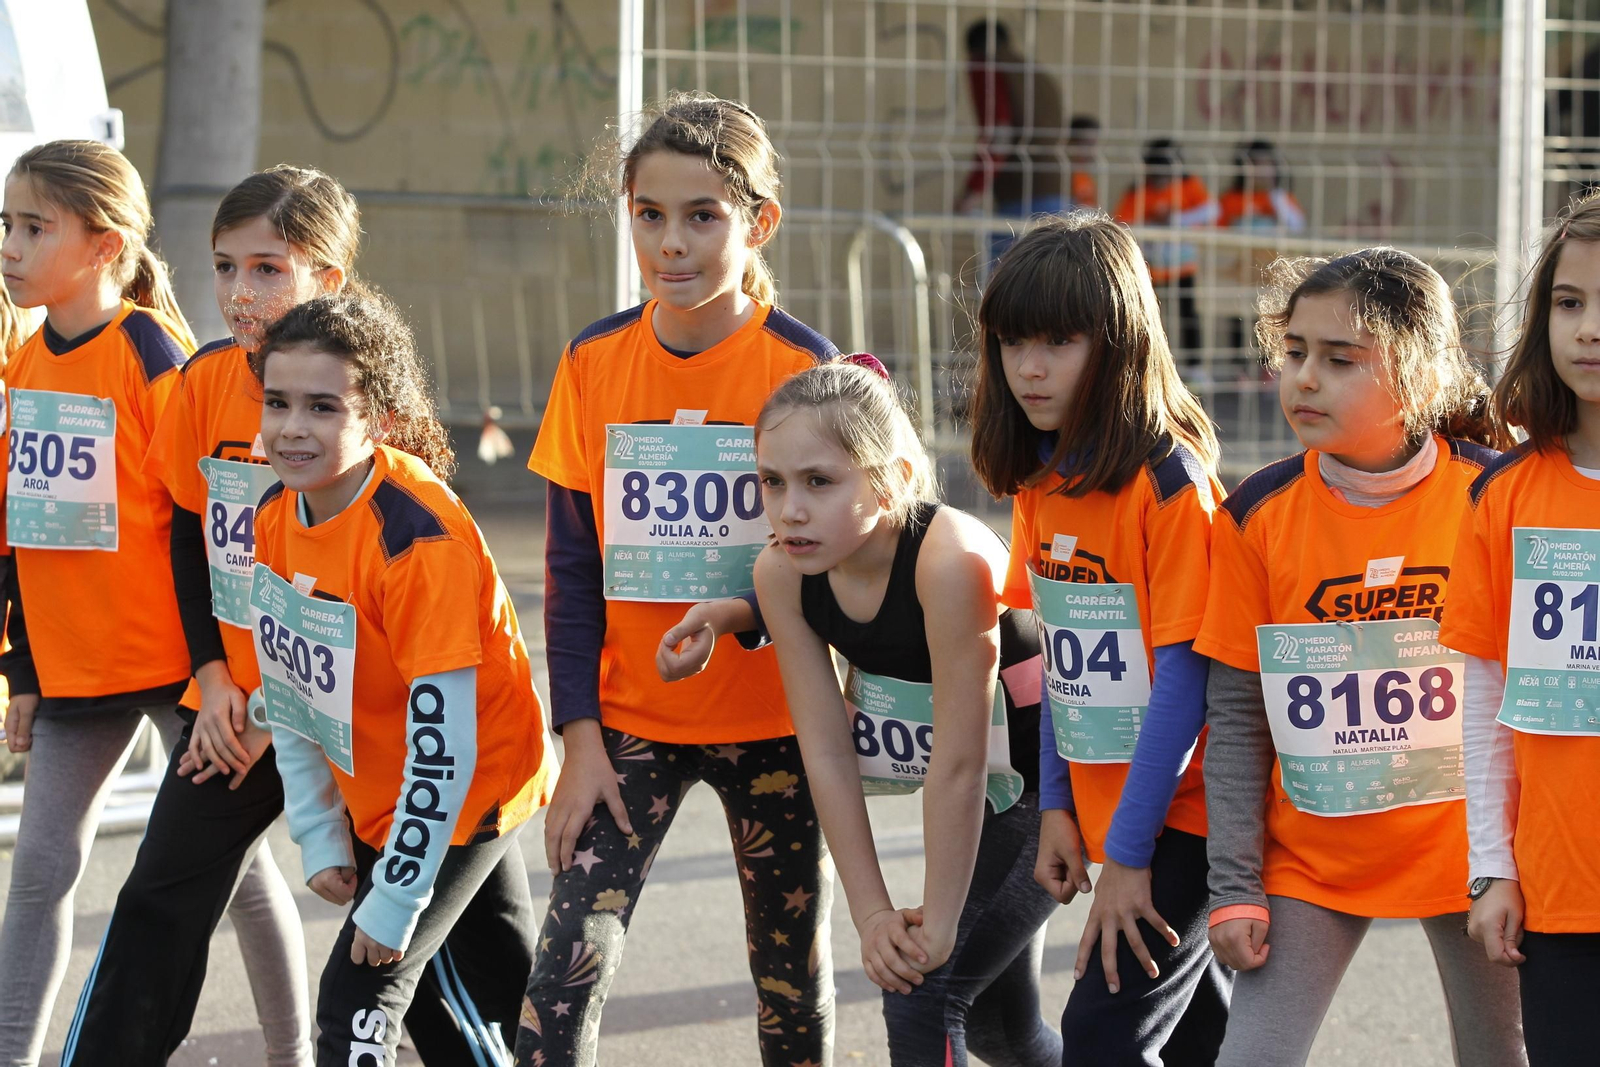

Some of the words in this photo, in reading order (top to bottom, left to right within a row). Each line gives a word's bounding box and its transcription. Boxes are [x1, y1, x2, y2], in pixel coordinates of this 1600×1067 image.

[58, 403, 106, 417] CARRERA
[59, 416, 106, 429] INFANTIL
[638, 444, 678, 452] MARATÓN
[638, 452, 673, 460] ALMERÍA
[23, 478, 50, 491] AROA
[622, 470, 764, 522] 8300
[212, 502, 255, 552] 84
[649, 524, 694, 537] JULIA
[698, 525, 714, 538] A.
[1555, 542, 1582, 550] MEDIO
[1554, 552, 1596, 561] MARATÓN
[1552, 561, 1590, 570] ALMERÍA
[1066, 594, 1126, 606] CARRERA
[1334, 582, 1440, 617] SUPER
[300, 606, 344, 624] CARRERA
[1069, 609, 1127, 620] INFANTIL
[1532, 582, 1600, 642] 81
[302, 620, 343, 638] INFANTIL
[1305, 636, 1335, 644] MEDIO
[260, 614, 336, 694] 8503
[1306, 644, 1352, 654] MARATÓN
[1306, 652, 1348, 663] ALMERÍA
[864, 688, 896, 703] MARATÓN
[1286, 667, 1456, 730] 8168
[1334, 728, 1408, 745] NATALIA
[384, 683, 454, 887] adidas
